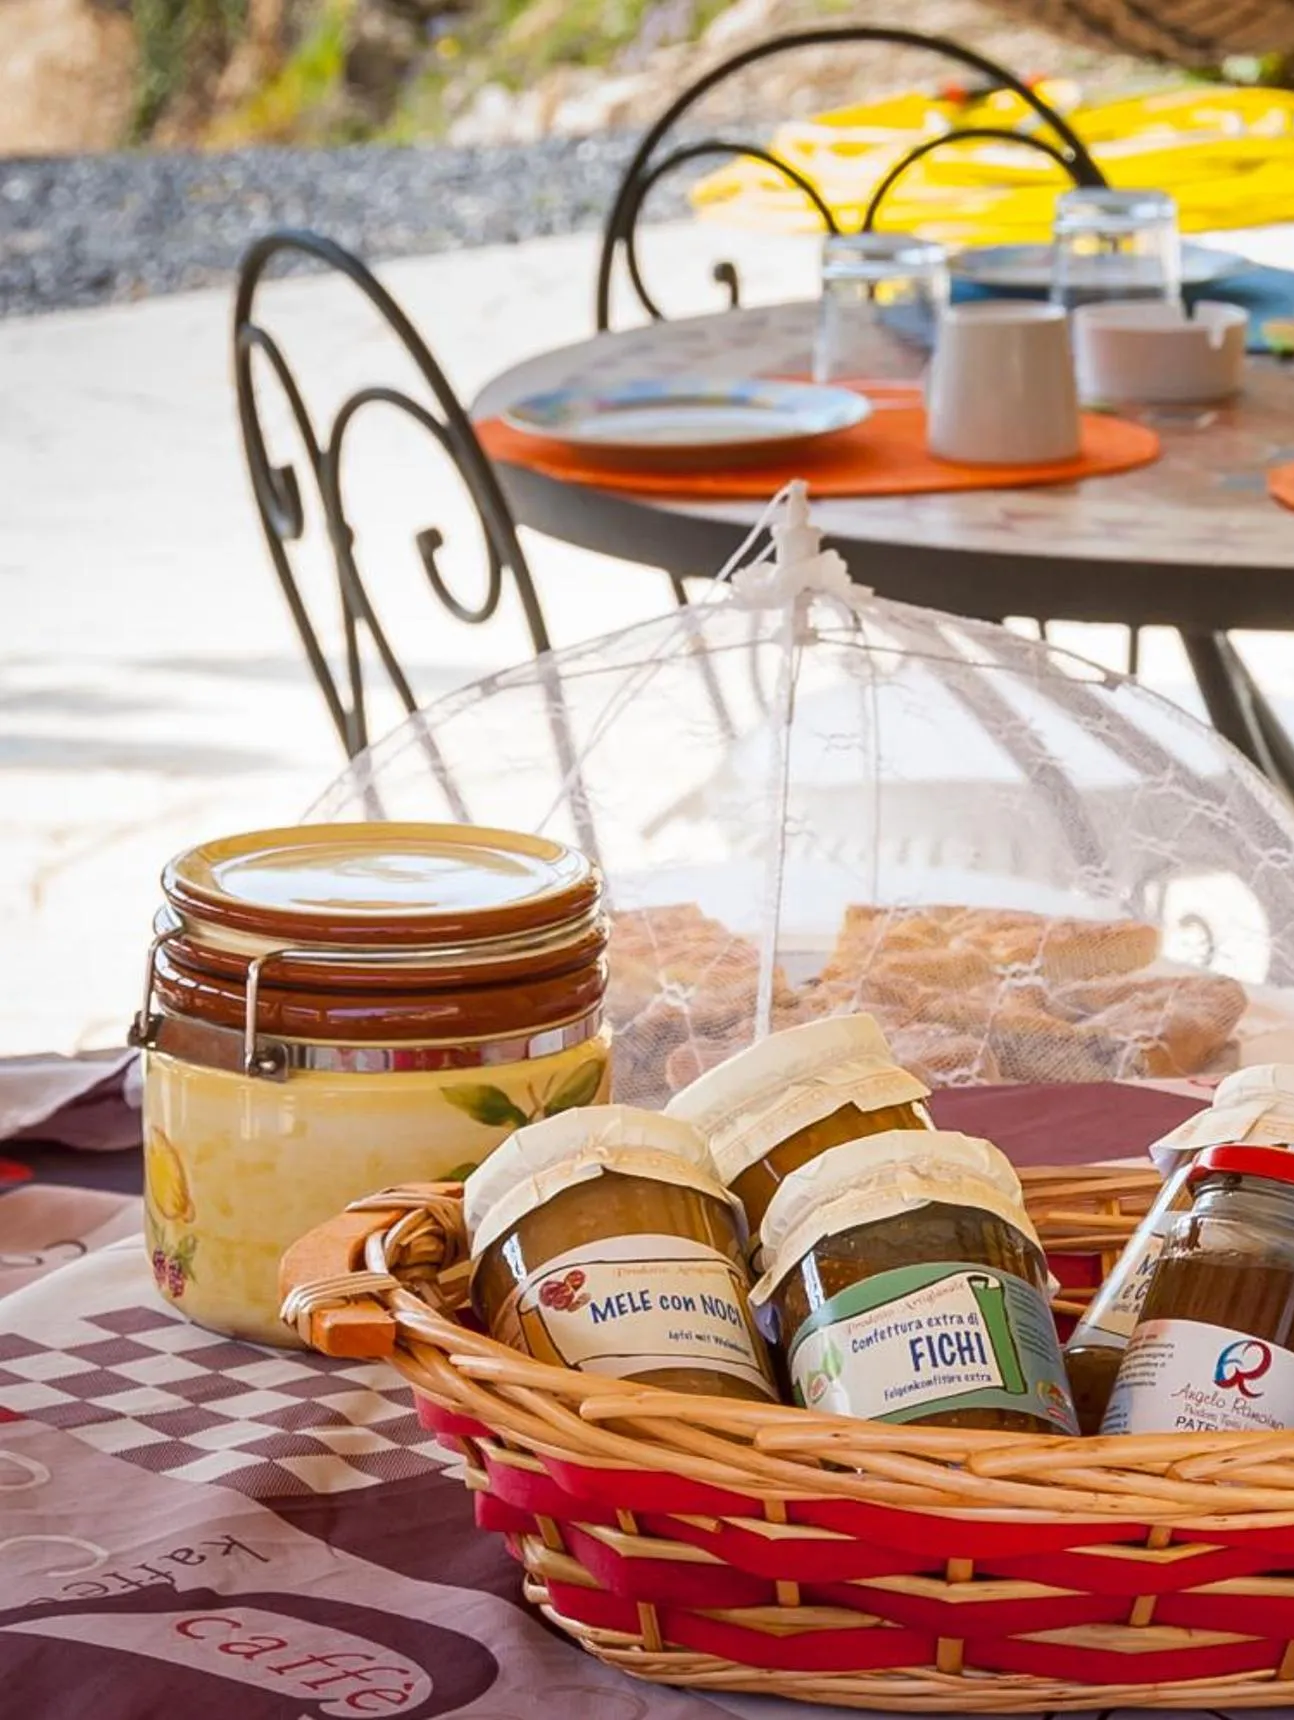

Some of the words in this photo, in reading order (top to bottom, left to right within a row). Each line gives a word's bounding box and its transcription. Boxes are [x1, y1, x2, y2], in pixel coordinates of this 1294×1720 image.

[590, 1289, 652, 1324] MELE
[659, 1294, 697, 1312] con
[700, 1293, 743, 1330] NOCI
[851, 1315, 923, 1354] Confettura
[926, 1312, 965, 1328] extra
[967, 1311, 980, 1326] di
[909, 1331, 989, 1372] FICHI
[1170, 1382, 1226, 1408] Angelo
[25, 1534, 271, 1605] kaffe
